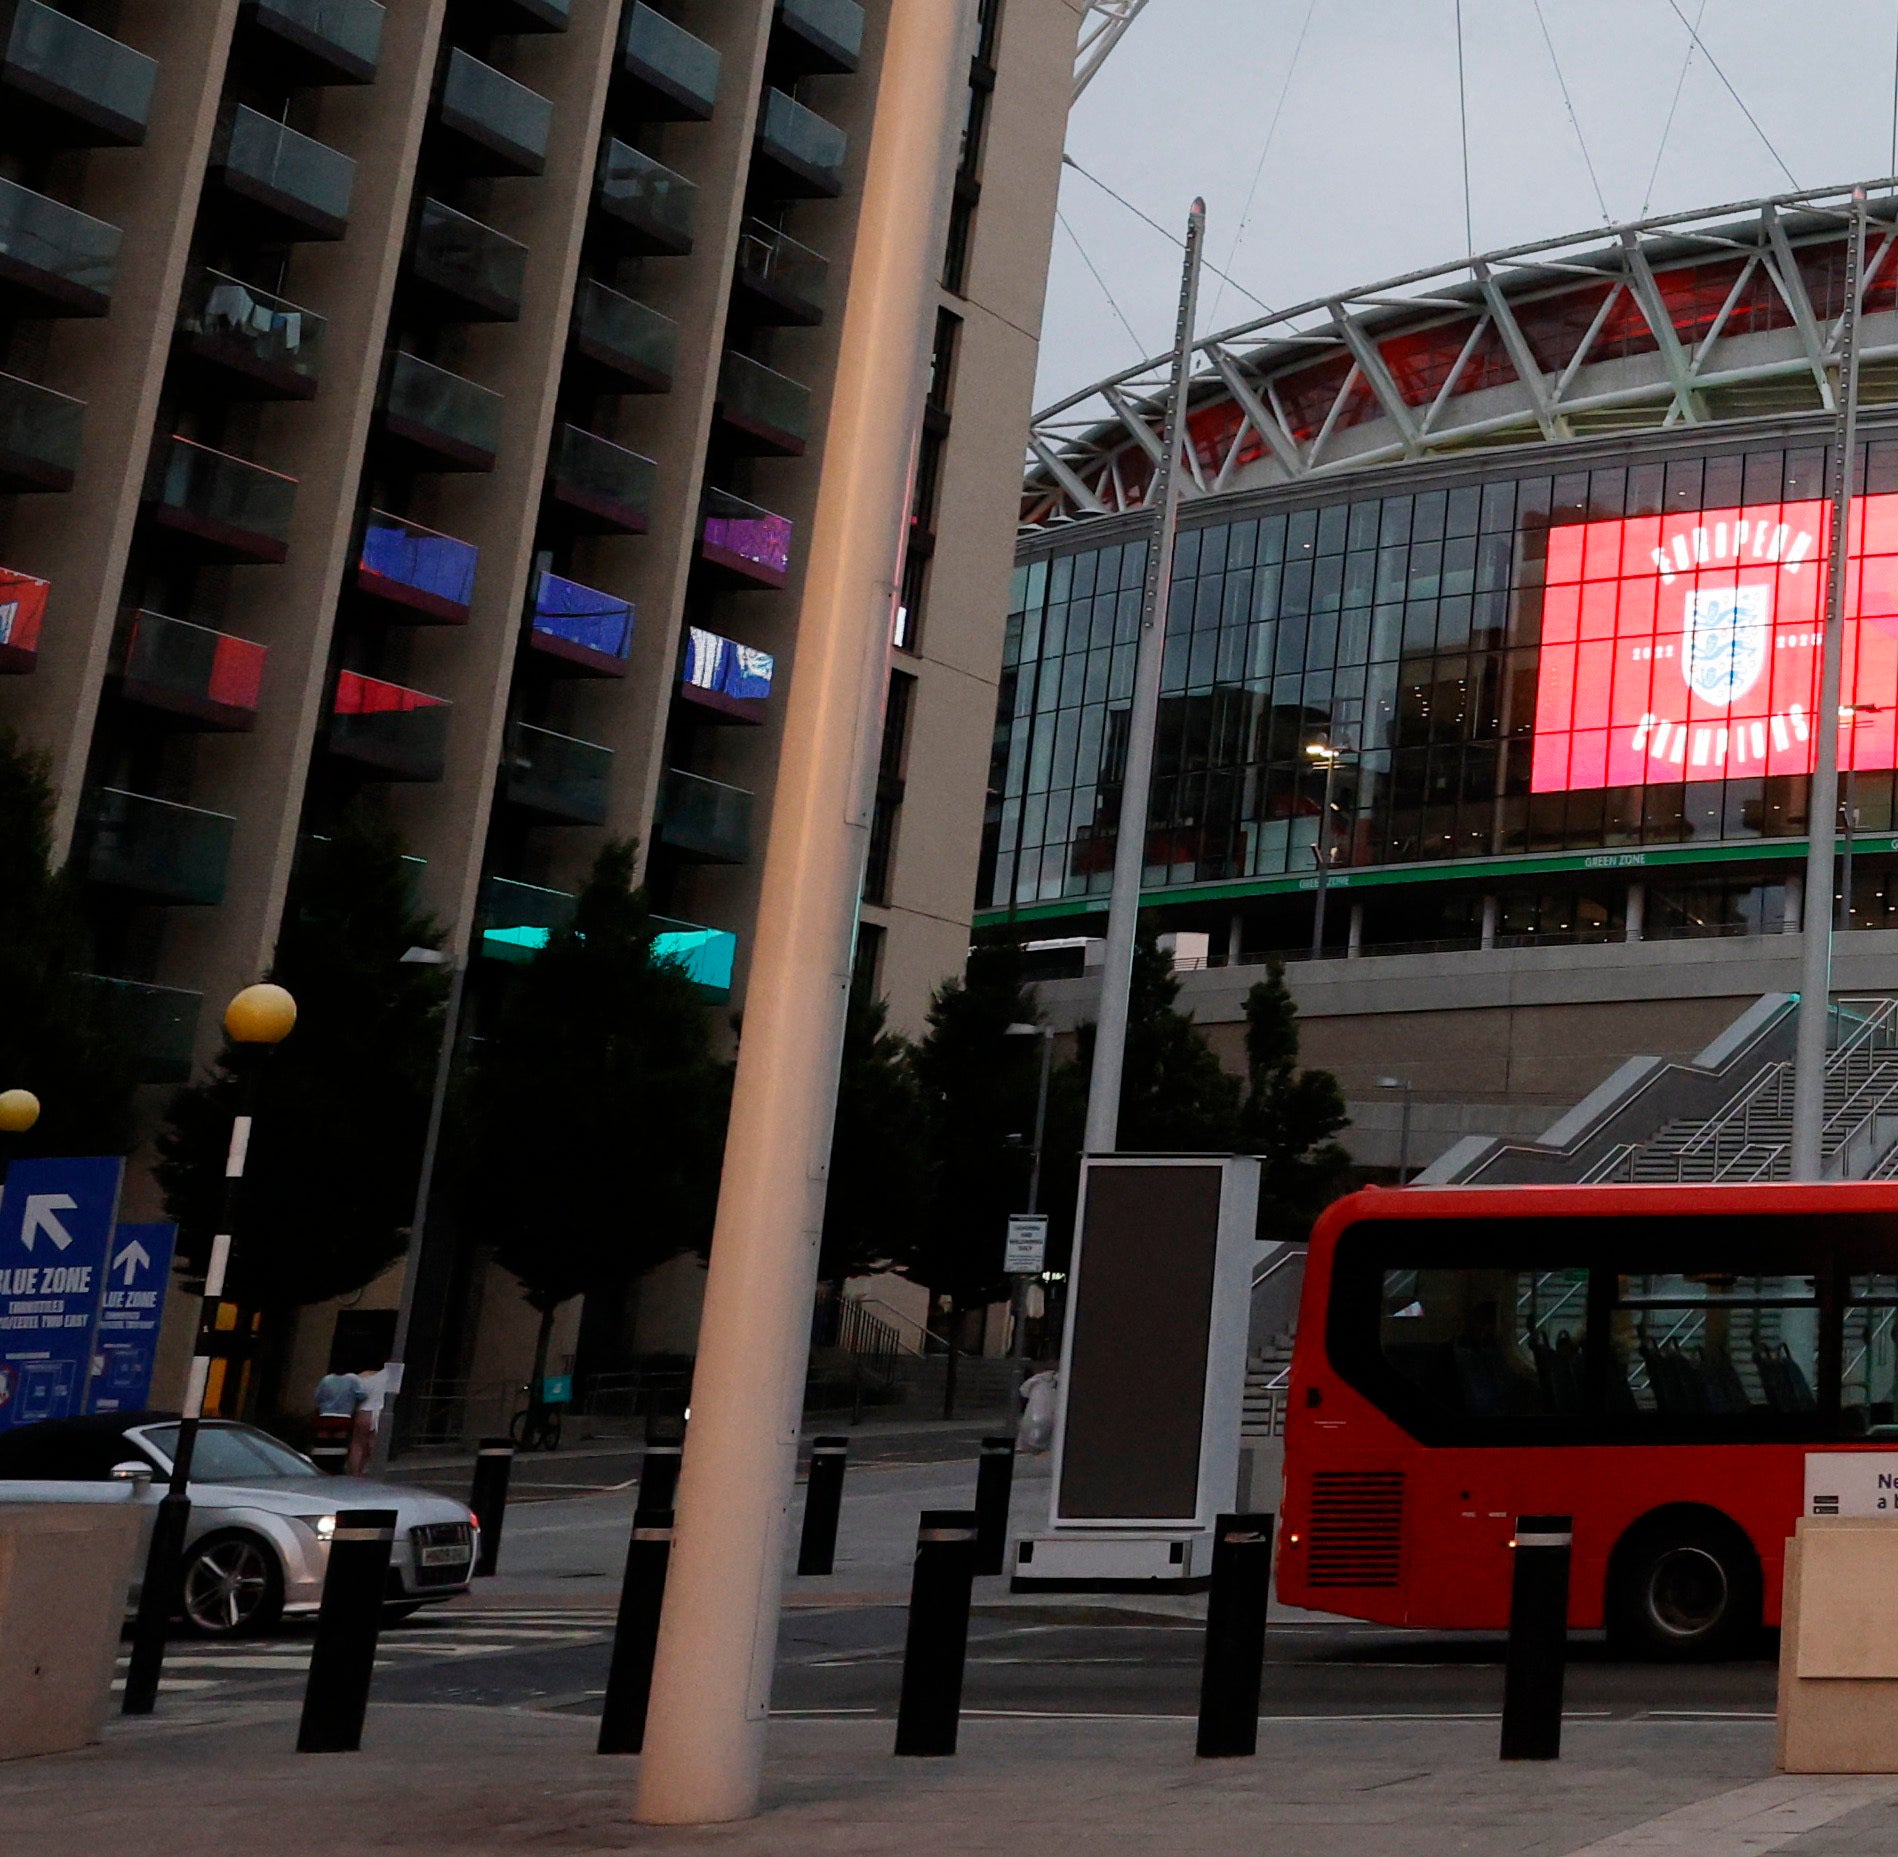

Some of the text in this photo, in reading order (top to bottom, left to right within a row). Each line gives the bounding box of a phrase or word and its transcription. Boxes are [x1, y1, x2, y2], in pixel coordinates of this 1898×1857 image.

[1651, 519, 1812, 585] EUROPEAN
[1632, 644, 1675, 661] 2022
[1632, 703, 1809, 766] CHAMPIONS
[1584, 853, 1646, 868] GREEN ZONE
[40, 1266, 93, 1295] ZONE
[103, 1291, 125, 1309] LUE
[1877, 1496, 1887, 1509] a
